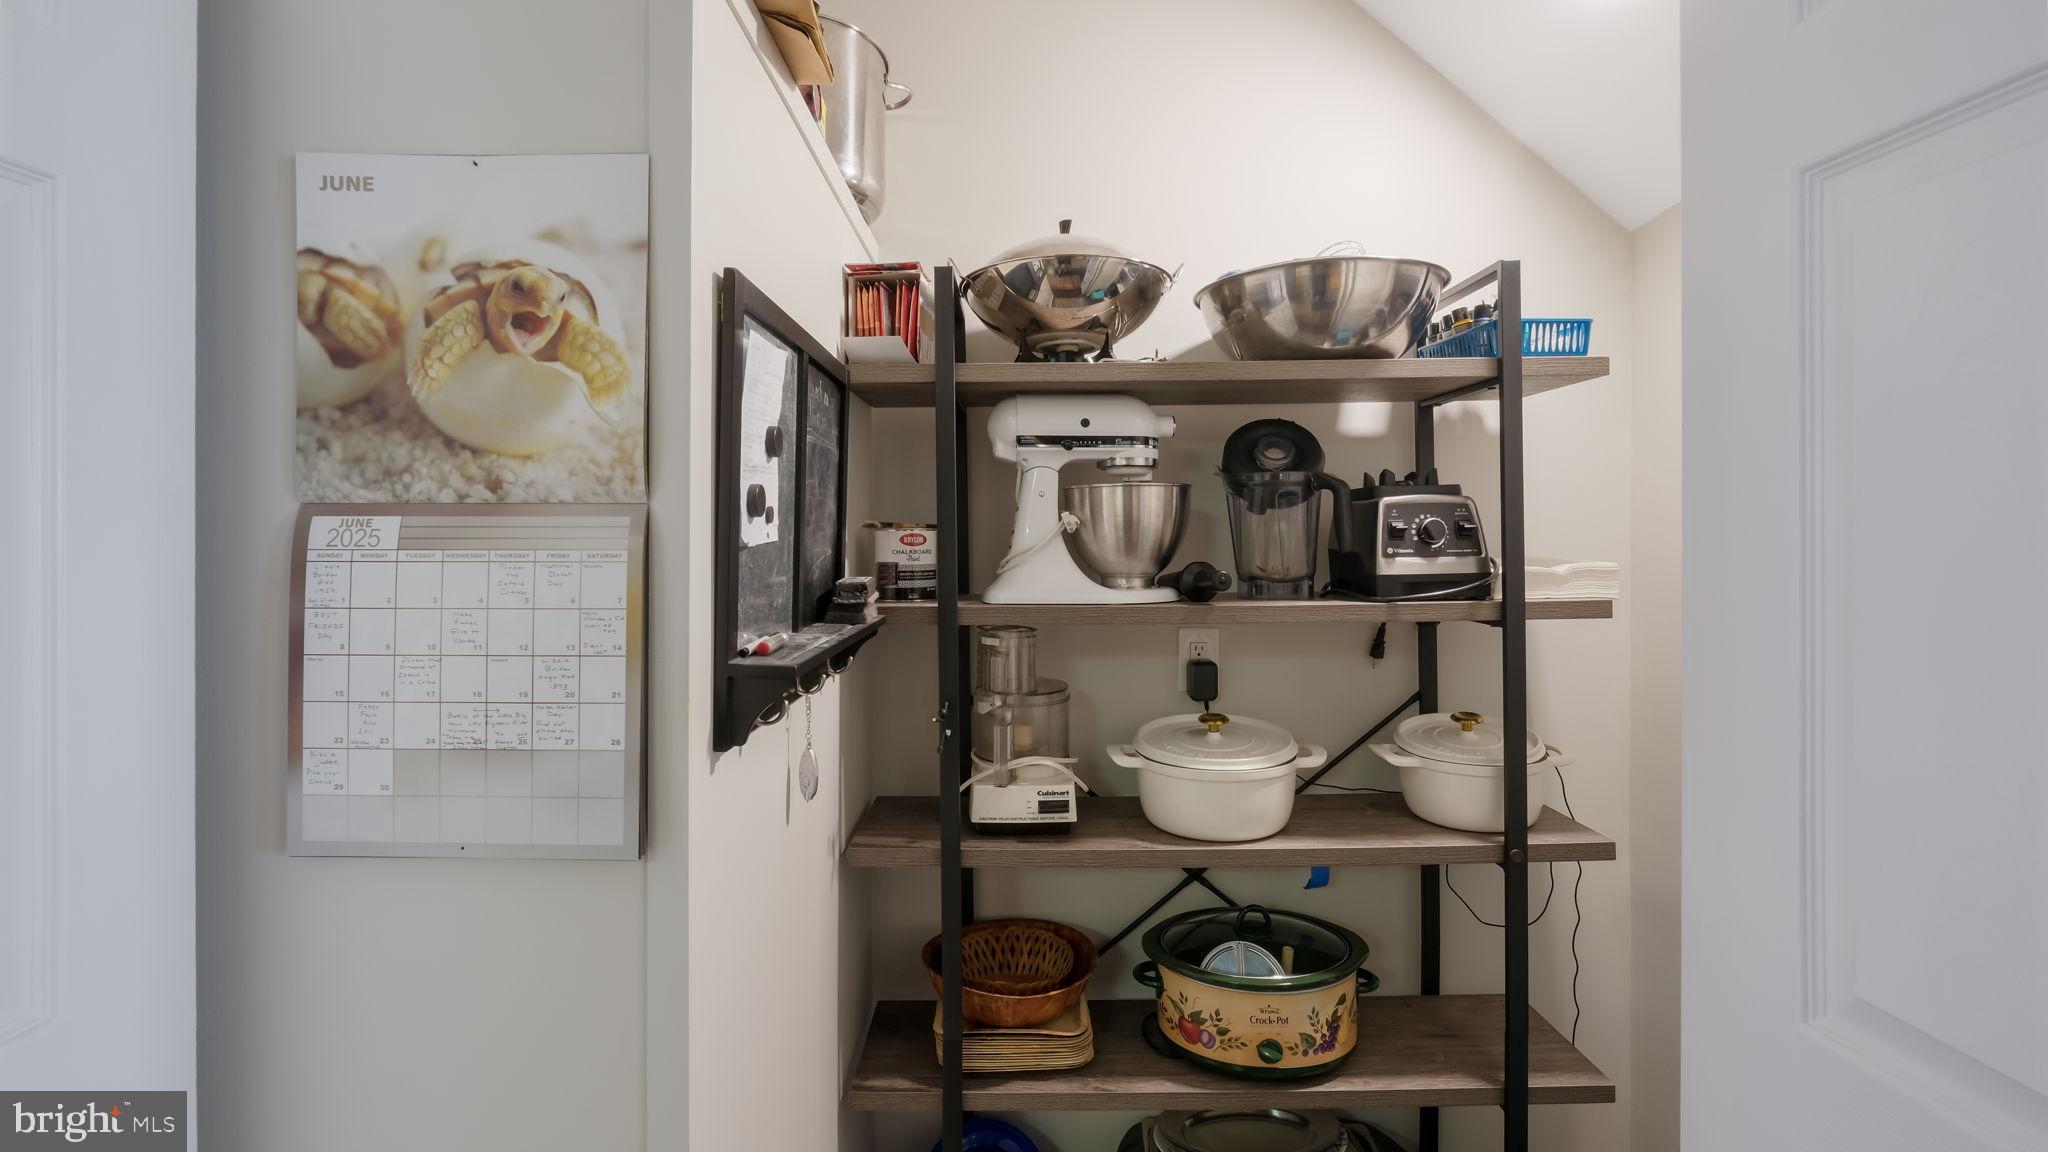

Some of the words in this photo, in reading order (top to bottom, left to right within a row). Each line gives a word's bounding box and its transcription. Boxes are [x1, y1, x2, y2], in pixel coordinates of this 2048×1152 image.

[319, 175, 375, 192] JUNE
[338, 518, 374, 528] JUNE
[325, 528, 382, 548] 2025
[564, 738, 575, 746] 27
[610, 738, 621, 746] 28
